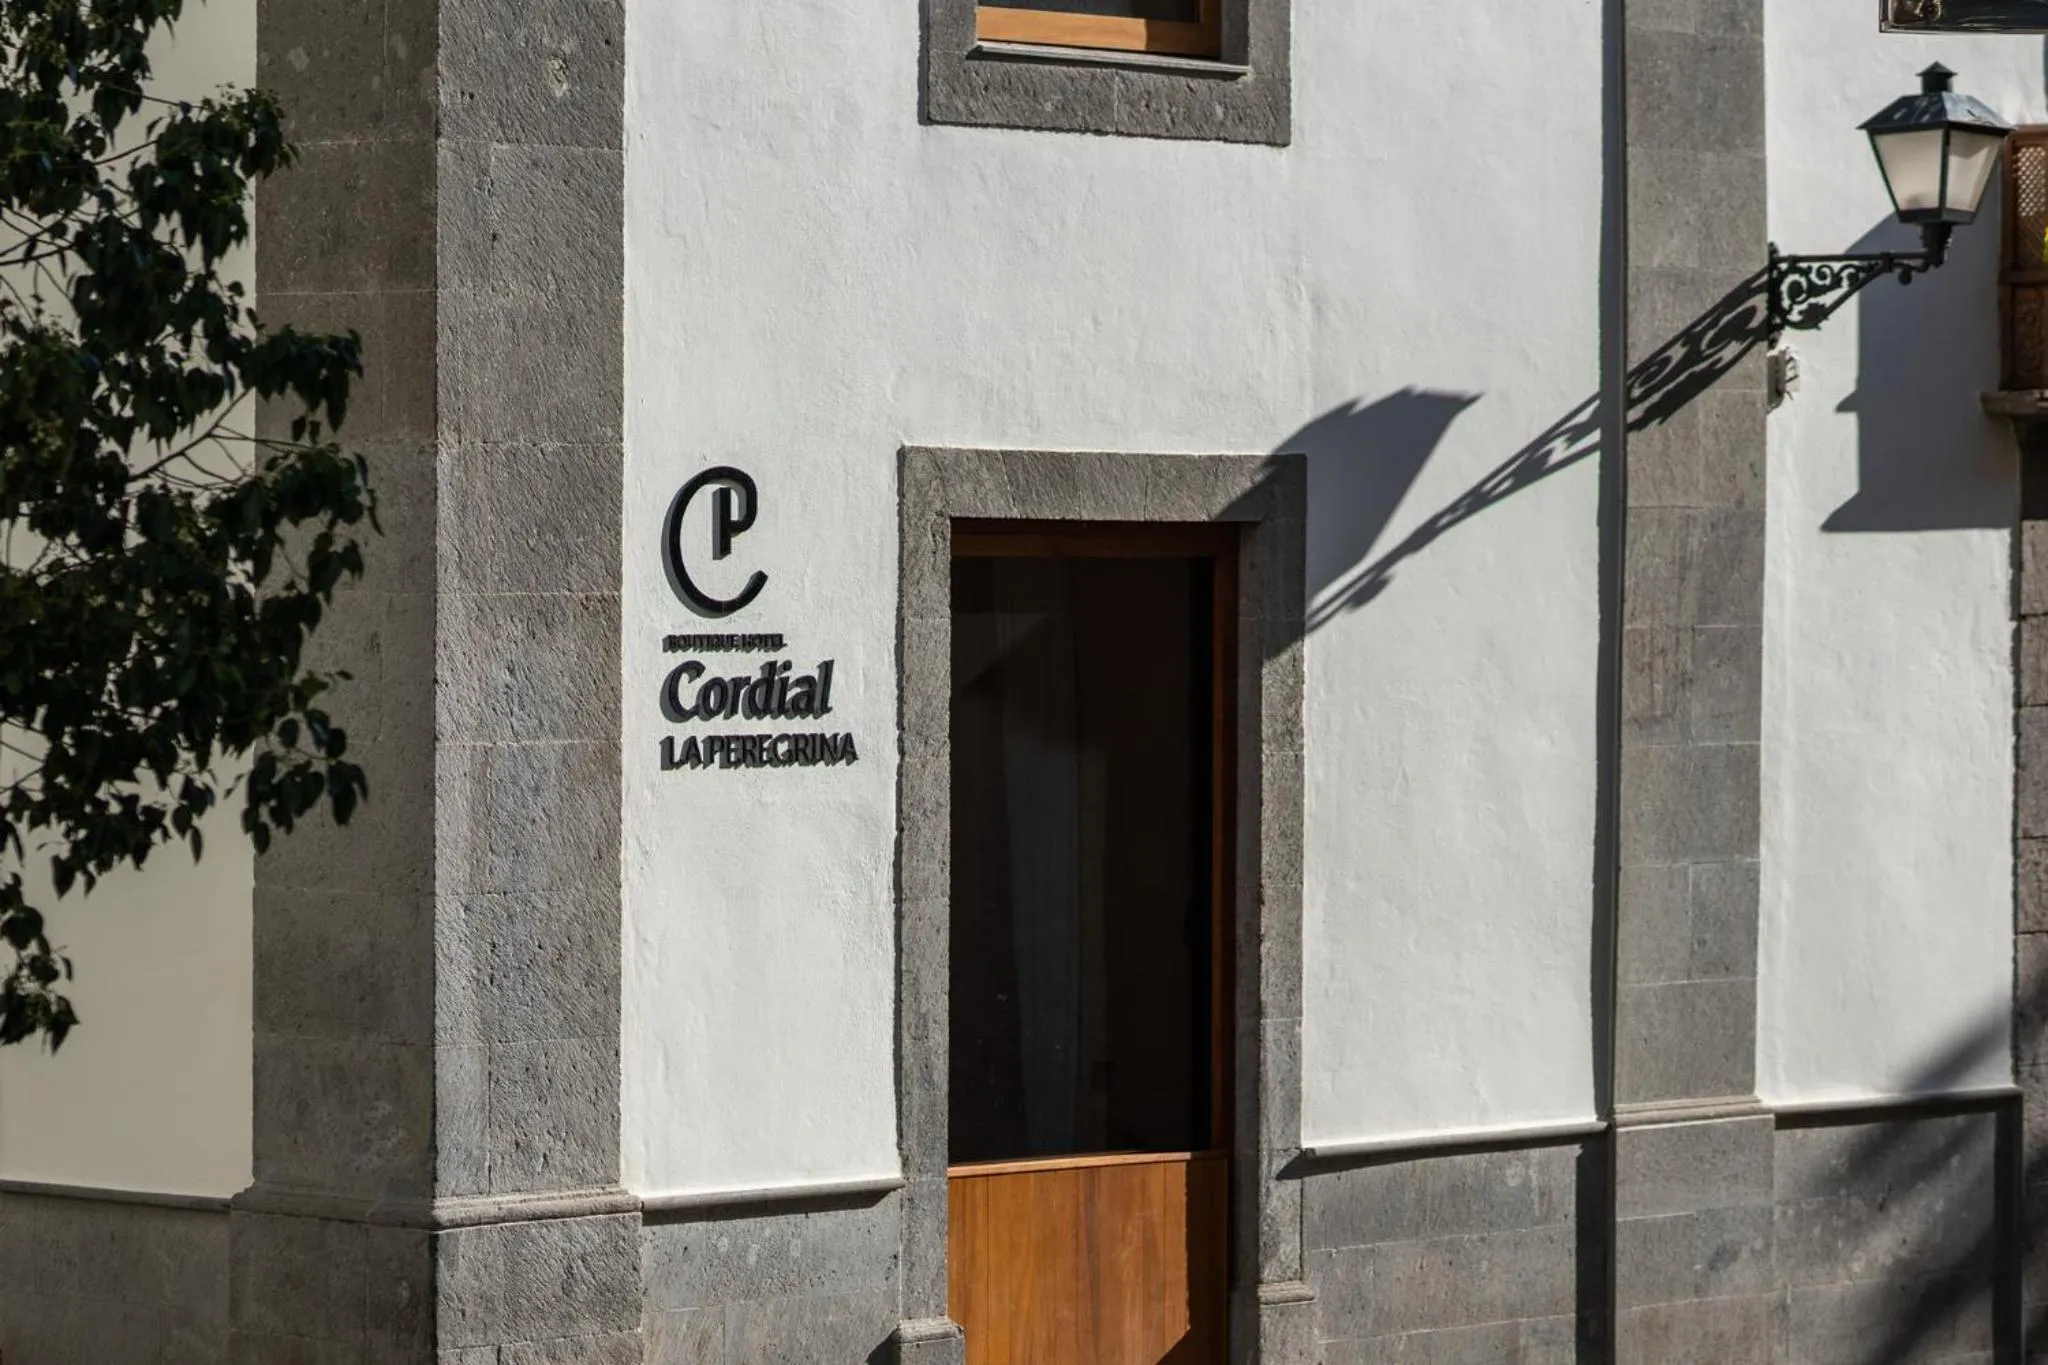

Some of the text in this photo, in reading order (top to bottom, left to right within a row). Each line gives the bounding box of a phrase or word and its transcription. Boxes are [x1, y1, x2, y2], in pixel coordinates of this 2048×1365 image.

[741, 633, 787, 651] HOTEL
[659, 659, 835, 723] Cordial
[659, 732, 859, 770] LA PEREGRINA
